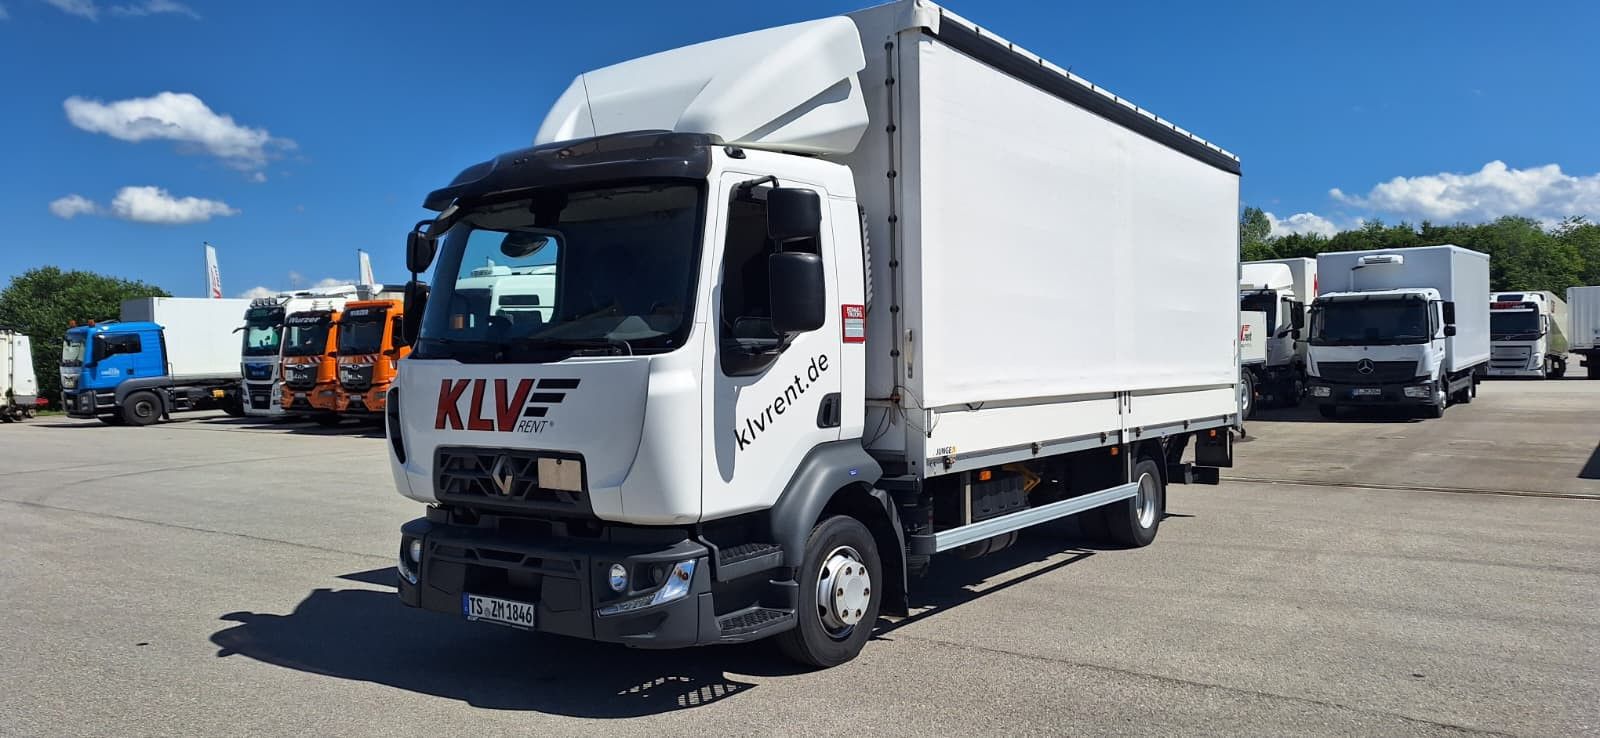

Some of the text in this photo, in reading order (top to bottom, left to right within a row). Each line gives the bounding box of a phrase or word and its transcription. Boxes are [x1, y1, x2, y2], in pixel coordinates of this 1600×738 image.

[288, 316, 321, 324] Wurzer
[434, 378, 536, 432] KLV
[733, 354, 829, 451] klvrent.de
[517, 420, 549, 433] RENT
[469, 597, 533, 624] TS ZM 1846
